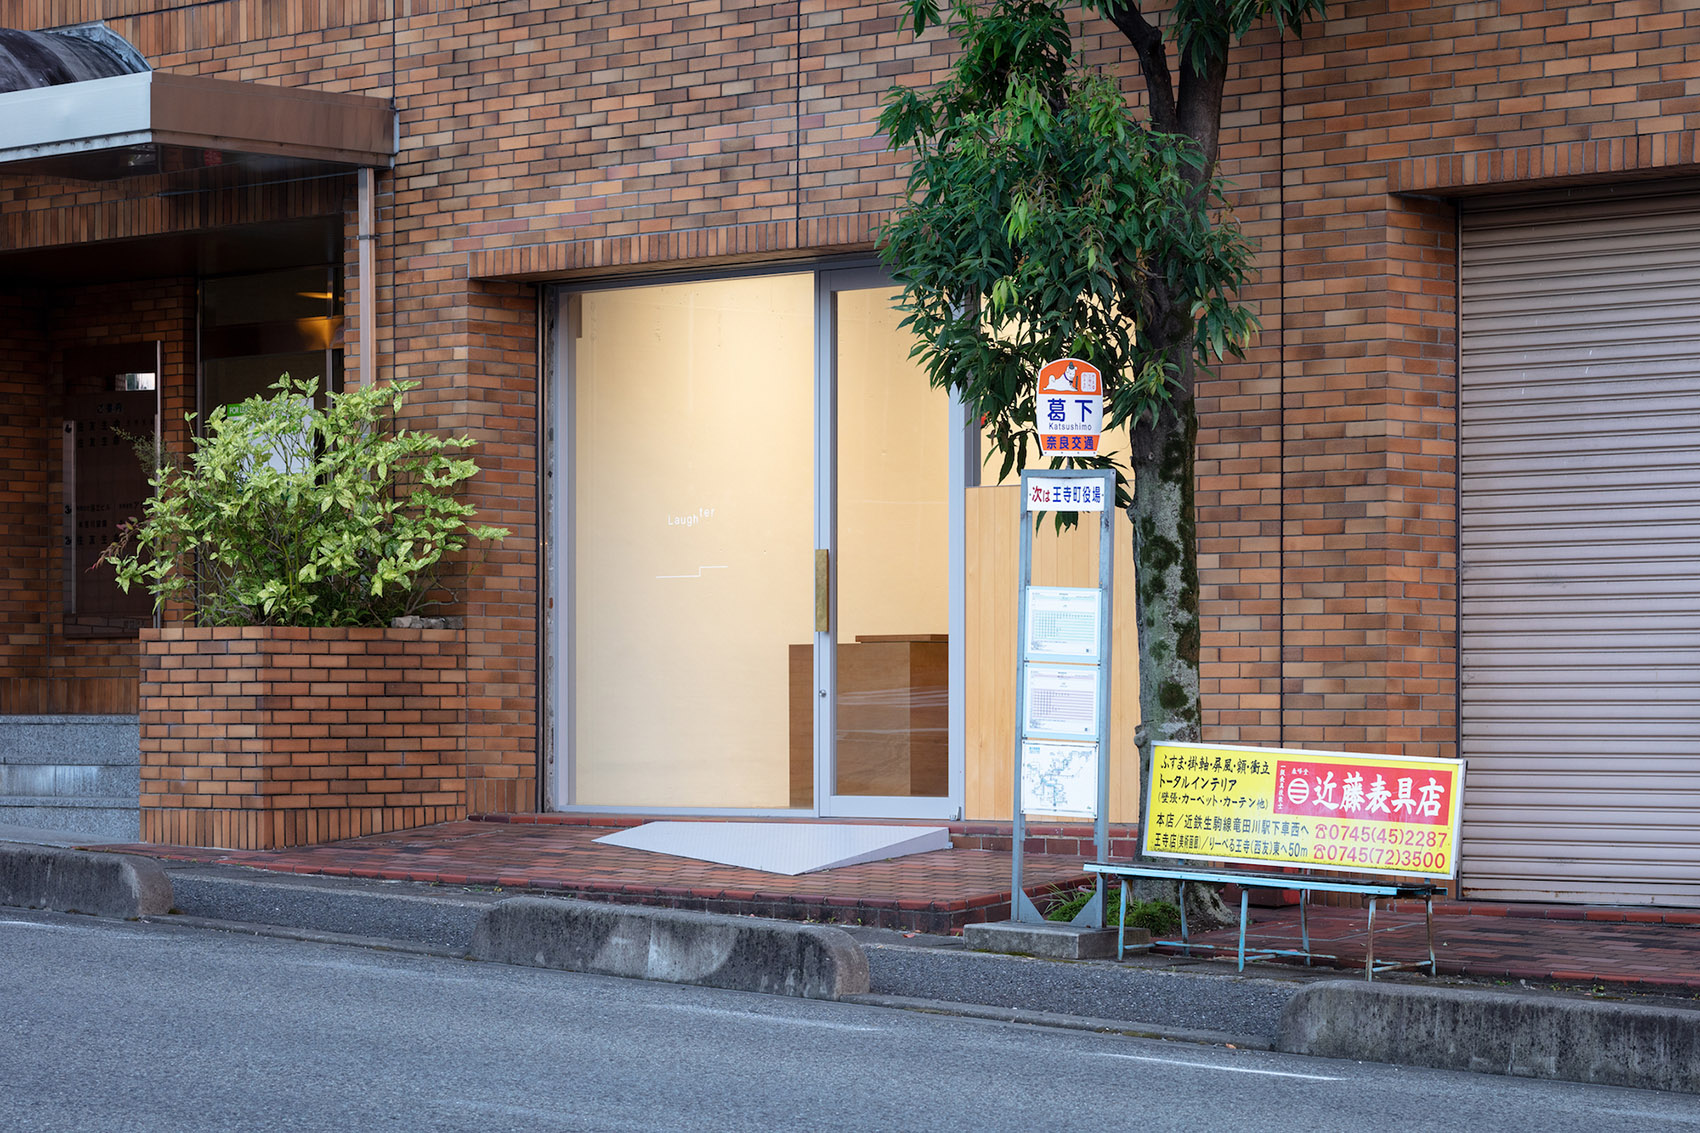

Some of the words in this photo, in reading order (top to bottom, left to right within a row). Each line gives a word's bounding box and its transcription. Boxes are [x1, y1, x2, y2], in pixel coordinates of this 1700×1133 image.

[229, 406, 239, 415] FOR
[1047, 398, 1093, 422] 葛下
[1048, 422, 1092, 431] Katsushimo
[1046, 436, 1094, 450] 奈良交通
[1032, 486, 1101, 503] 次は王寺町役場
[667, 507, 715, 527] Laughter
[1159, 773, 1237, 792] トータルインテリア
[1311, 771, 1445, 817] 近藤表具店
[1329, 824, 1447, 848] 0745(45)2287
[1327, 844, 1445, 869] 0745(72)3500
